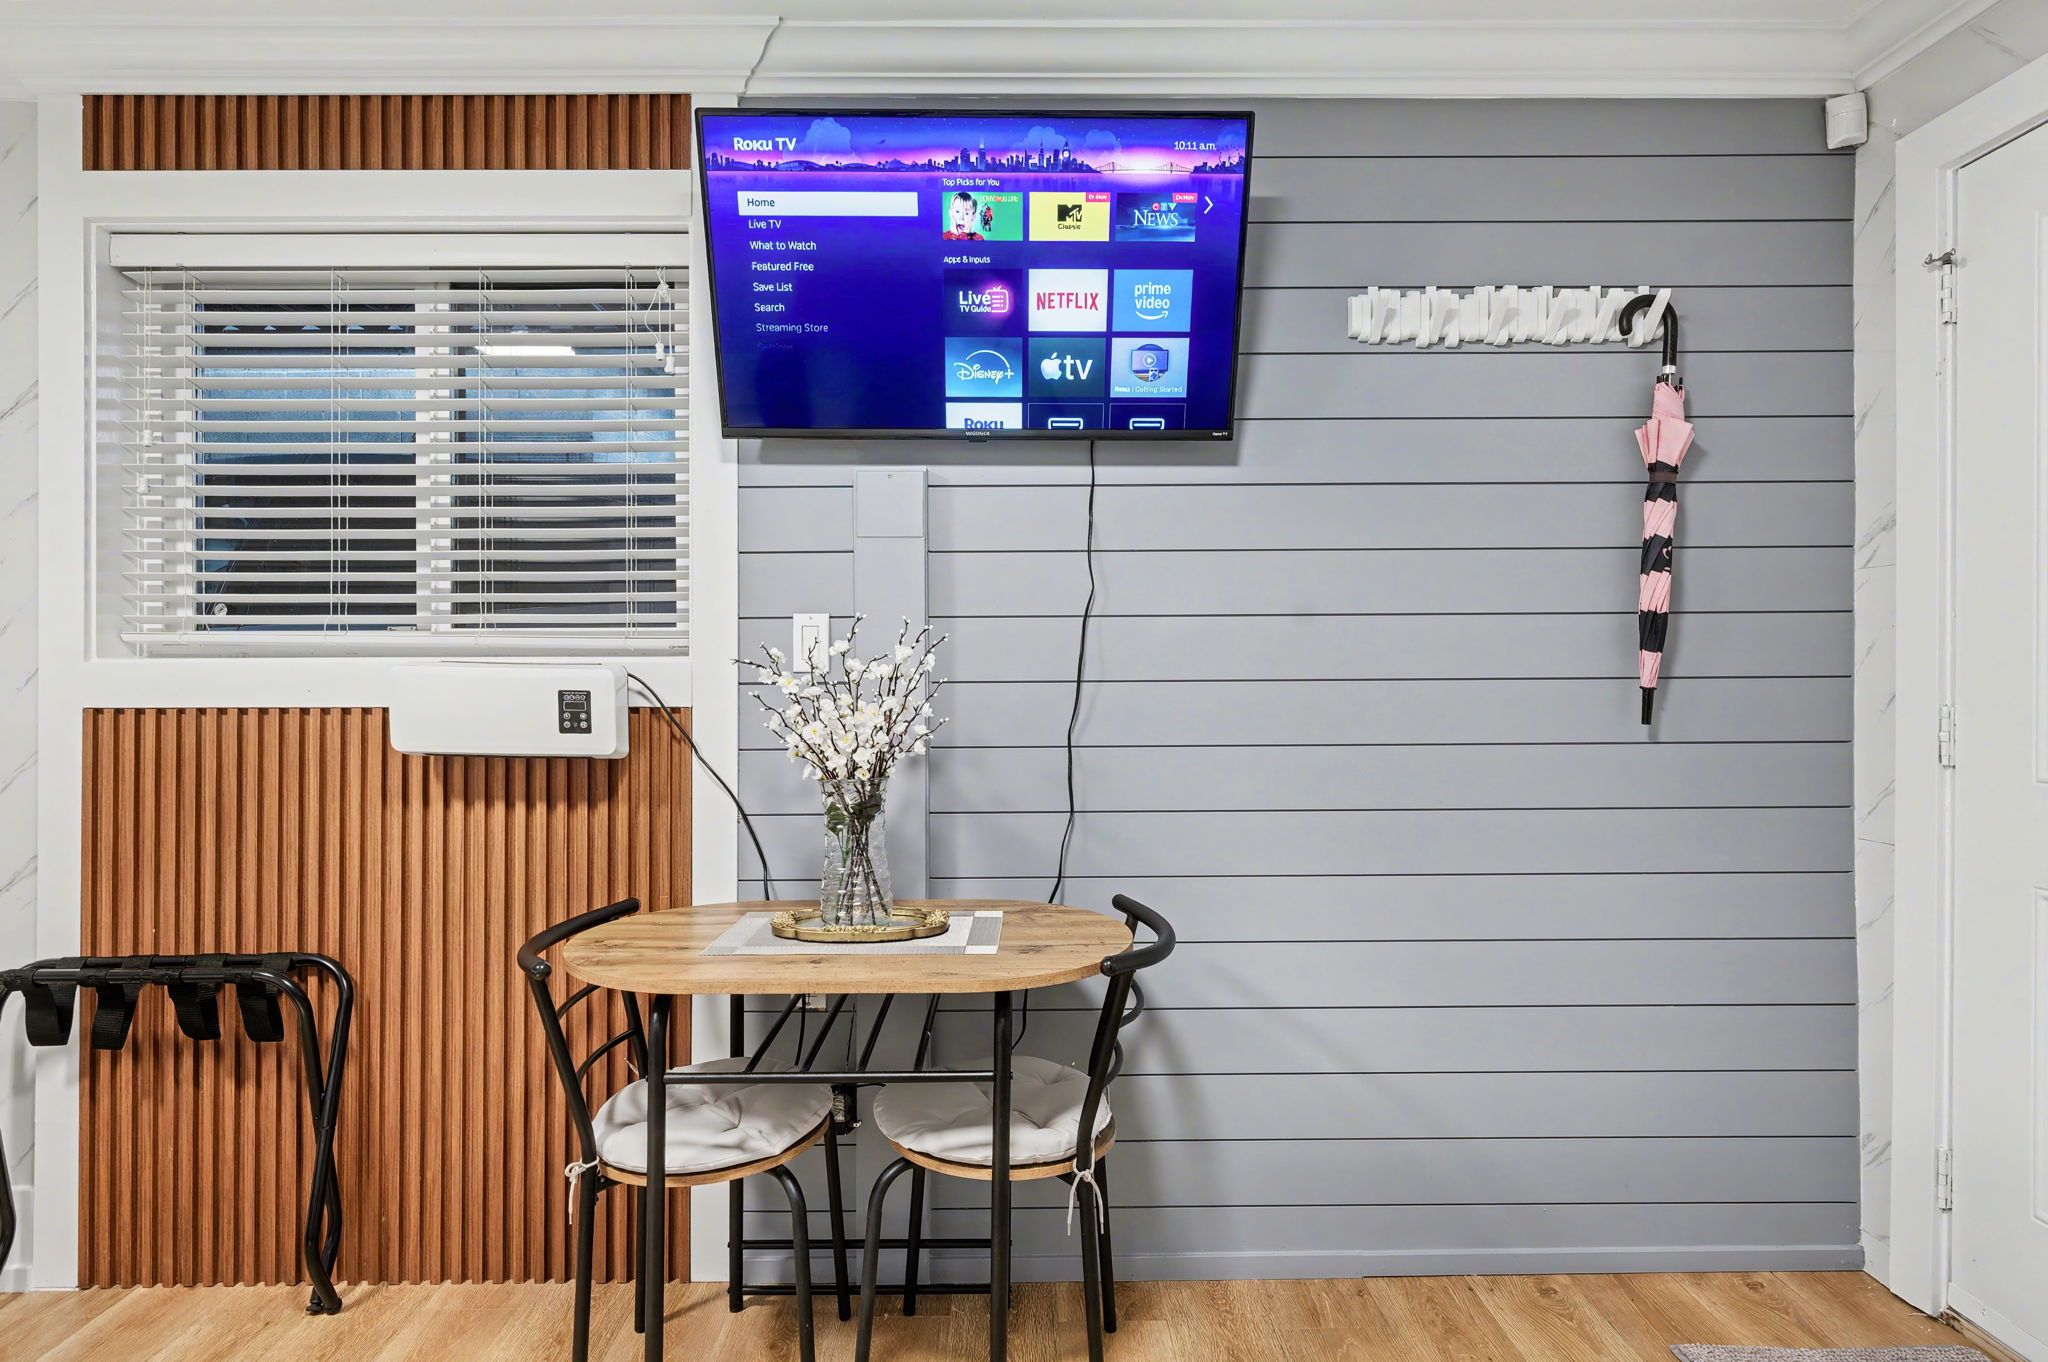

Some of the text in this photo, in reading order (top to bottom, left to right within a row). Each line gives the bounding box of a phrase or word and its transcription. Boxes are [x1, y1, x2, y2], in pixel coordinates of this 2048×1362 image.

[733, 137, 797, 151] Roku TV
[943, 178, 955, 187] Top
[956, 178, 974, 186] Picks
[975, 178, 985, 186] for
[747, 198, 775, 207] Home
[748, 220, 782, 229] Live TV
[750, 241, 817, 250] What to Watch
[969, 256, 991, 264] Inputs
[752, 262, 814, 271] Featured Free
[753, 282, 793, 292] Save List
[1134, 282, 1171, 296] prime
[959, 290, 992, 305] Live
[1036, 292, 1099, 311] NETFLIX
[754, 303, 785, 312] Search
[1135, 298, 1170, 309] video
[756, 323, 829, 334] Streaming Store
[1064, 354, 1093, 380] tv
[953, 361, 1014, 385] Disney+
[1135, 386, 1158, 394] Getting
